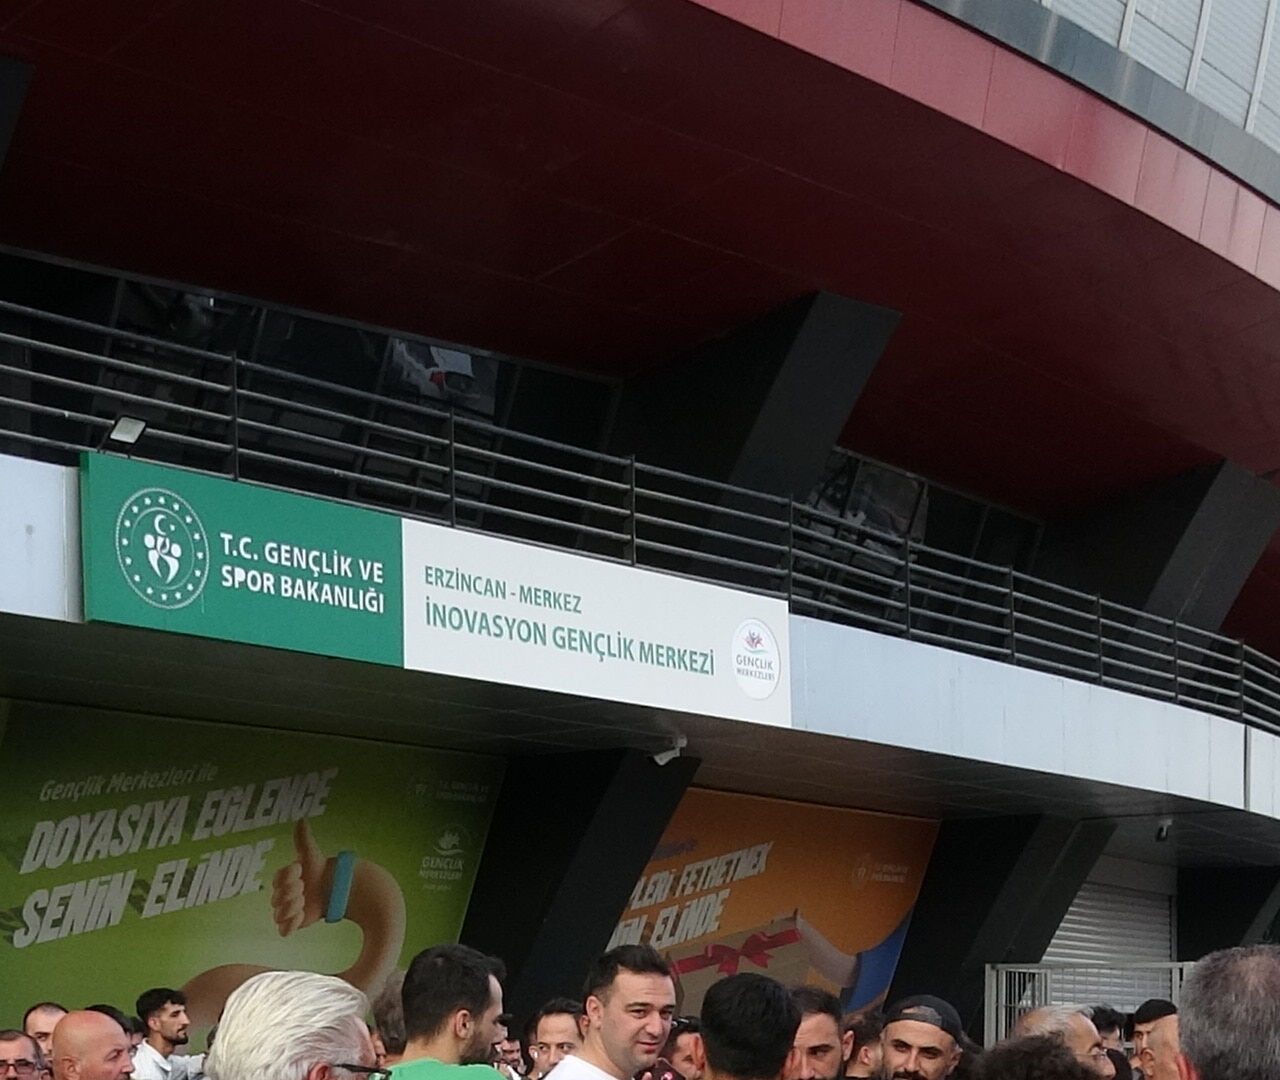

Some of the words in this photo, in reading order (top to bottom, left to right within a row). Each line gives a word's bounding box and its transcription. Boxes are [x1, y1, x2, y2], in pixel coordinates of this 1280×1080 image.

[219, 532, 258, 561] T.C.
[264, 541, 353, 578] GENÇLİK
[358, 558, 384, 584] VE
[221, 564, 275, 595] SPOR
[280, 575, 385, 614] BAKANLIĞI
[424, 565, 507, 600] ERZİNCAN
[519, 584, 583, 614] MERKEZ
[425, 595, 547, 646] İNOVASYON
[552, 625, 635, 663] GENÇLİK
[638, 640, 715, 676] MERKEZİ
[39, 774, 104, 802] Gençlik
[105, 765, 197, 794] Merkezleri
[198, 761, 219, 783] ile
[19, 796, 192, 875] DOYASIYA
[13, 868, 138, 949] SENİN
[140, 838, 277, 919] ELİNDE
